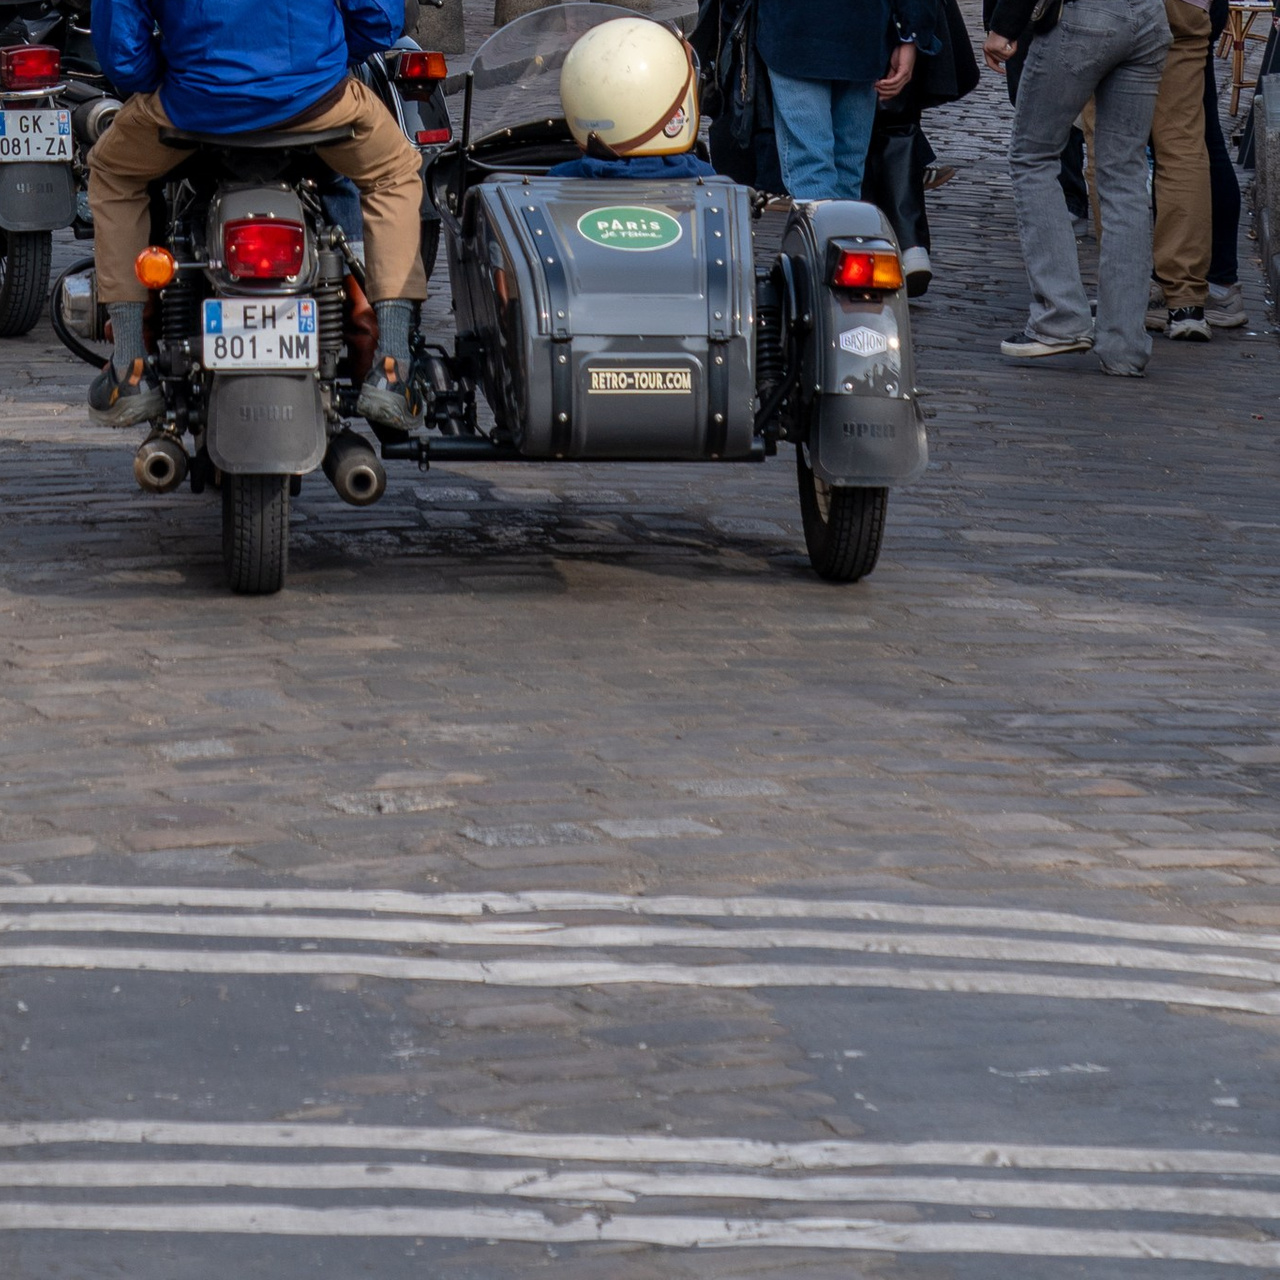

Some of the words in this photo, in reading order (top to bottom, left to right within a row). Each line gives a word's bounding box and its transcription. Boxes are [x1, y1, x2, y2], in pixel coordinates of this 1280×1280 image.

[60, 124, 70, 134] 75
[211, 320, 217, 328] F
[300, 318, 314, 331] 75
[845, 331, 883, 351] BASTION
[591, 371, 692, 390] RETRO-TOUR.COM
